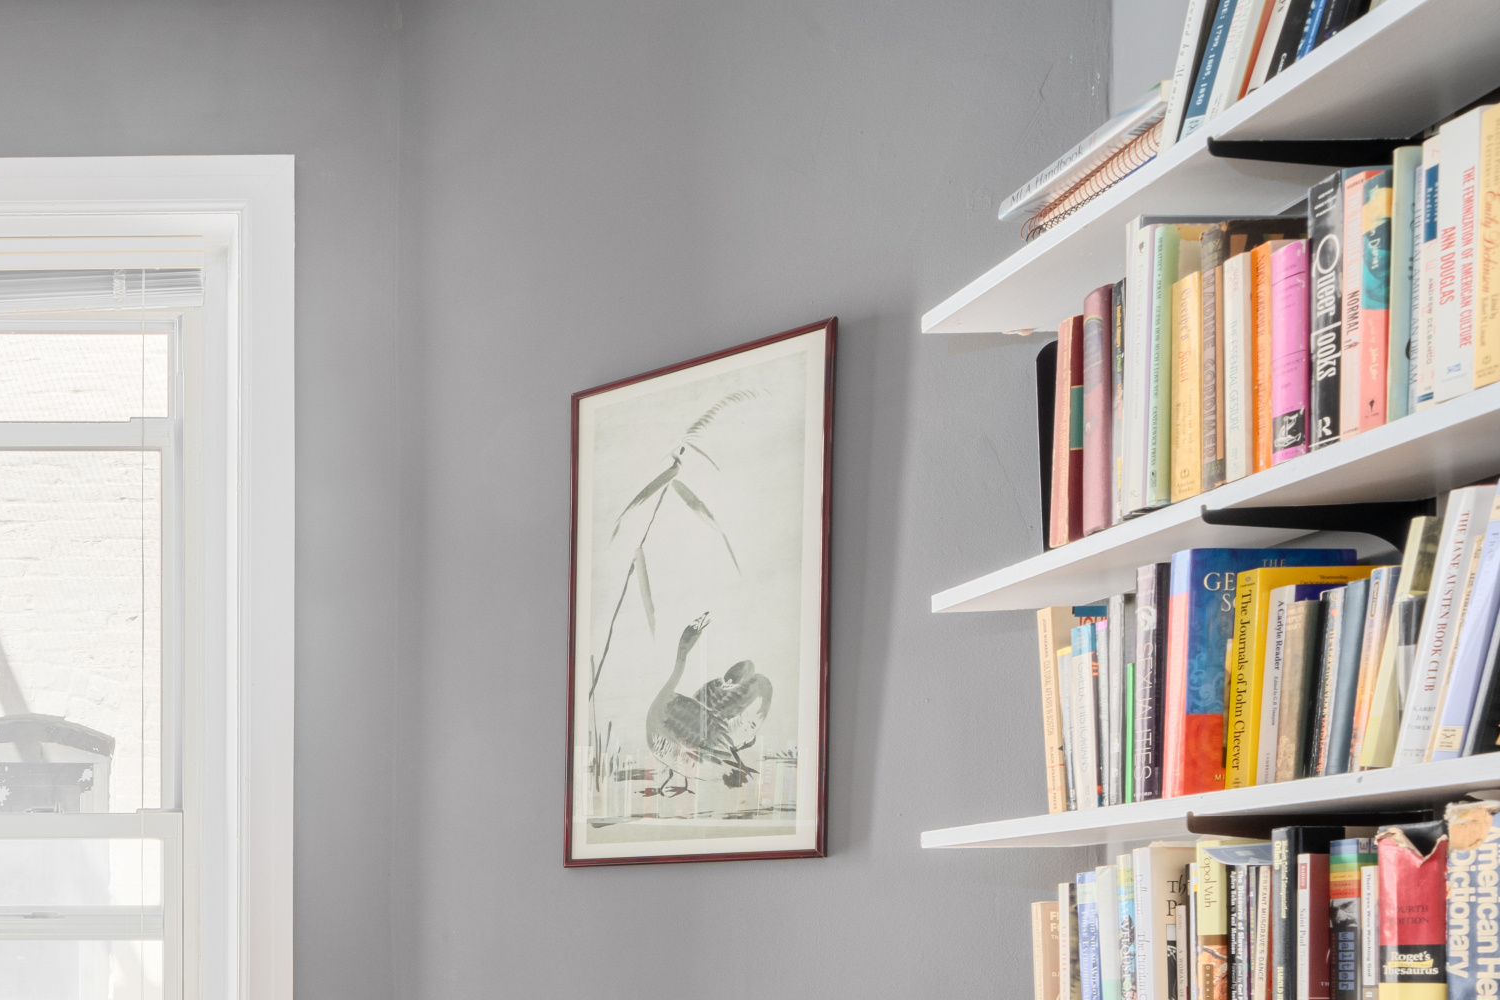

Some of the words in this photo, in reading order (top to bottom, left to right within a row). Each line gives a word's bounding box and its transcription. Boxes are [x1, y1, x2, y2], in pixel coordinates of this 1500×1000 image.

[1209, 25, 1223, 51] 1799,
[1202, 54, 1215, 80] 1805,
[1195, 82, 1207, 106] 1850
[1010, 184, 1032, 206] MLA
[1035, 144, 1085, 187] Handbook
[1463, 165, 1475, 186] THE
[1347, 190, 1360, 214] THE
[1414, 208, 1422, 232] THE
[1461, 185, 1474, 249] FEMINIZATION
[1481, 190, 1500, 229] Emily
[1347, 215, 1360, 262] TROUBLE
[1368, 238, 1381, 270] Diaries
[1412, 234, 1422, 263] REAL
[1441, 226, 1456, 251] ANN
[1461, 249, 1474, 260] OF
[1257, 255, 1265, 286] NADINE
[1312, 234, 1340, 318] Queer
[1347, 263, 1360, 290] WITH
[1439, 251, 1456, 306] DOUGLAS
[1481, 230, 1499, 293] Dickinson
[1410, 268, 1420, 336] AMERICAN
[1460, 262, 1473, 308] AMERICAN
[1180, 287, 1192, 341] Goethe's
[1203, 273, 1215, 351] NADINE
[1230, 320, 1238, 336] THE
[1257, 290, 1266, 337] GORDIMER
[1347, 290, 1359, 336] NORMAL
[1459, 309, 1473, 348] CULTURE
[1229, 340, 1238, 386] ESSENTIAL
[1311, 321, 1342, 381] Looks
[1408, 338, 1419, 385] DREAM
[1203, 358, 1216, 458] GORDIMER
[1229, 390, 1238, 433] GESTURE
[1459, 510, 1470, 535] THE
[1262, 559, 1286, 568] THE
[1453, 537, 1464, 570] JANE
[1241, 589, 1252, 616] The
[1443, 573, 1457, 619] AUSTEN
[1275, 609, 1286, 639] Carlyle
[1431, 621, 1448, 657] BOOK
[1237, 619, 1250, 670] Journals
[1274, 640, 1283, 670] Reader
[1043, 660, 1051, 687] CULTURAL
[1077, 662, 1086, 701] GREEK
[1236, 673, 1247, 686] of
[1424, 659, 1441, 693] CLUB
[1135, 642, 1153, 781] SEXUALITIES
[1235, 688, 1247, 718] John
[1322, 675, 1333, 715] Notebook
[1046, 714, 1054, 736] BOSTON
[1077, 705, 1089, 773] HISTORIANS
[1232, 720, 1245, 770] Cheever
[1204, 888, 1217, 908] Vuh
[1261, 870, 1269, 906] SERJEANT
[1279, 880, 1288, 918] Interpretations
[1237, 922, 1243, 930] of
[1389, 905, 1429, 913] FOURTH
[1389, 917, 1429, 925] EDITION
[1447, 849, 1477, 978] Dictionary
[1088, 908, 1097, 963] PUDD'NHEAD
[1118, 894, 1132, 971] MARVELOUS
[1137, 930, 1150, 950] The
[1259, 908, 1267, 955] MUSGRAVE'S
[1137, 953, 1146, 991] Puritan
[1257, 956, 1265, 982] DANCE
[1341, 932, 1352, 989] walter
[1383, 965, 1439, 976] Thesaurus
[1390, 951, 1431, 963] Roget's
